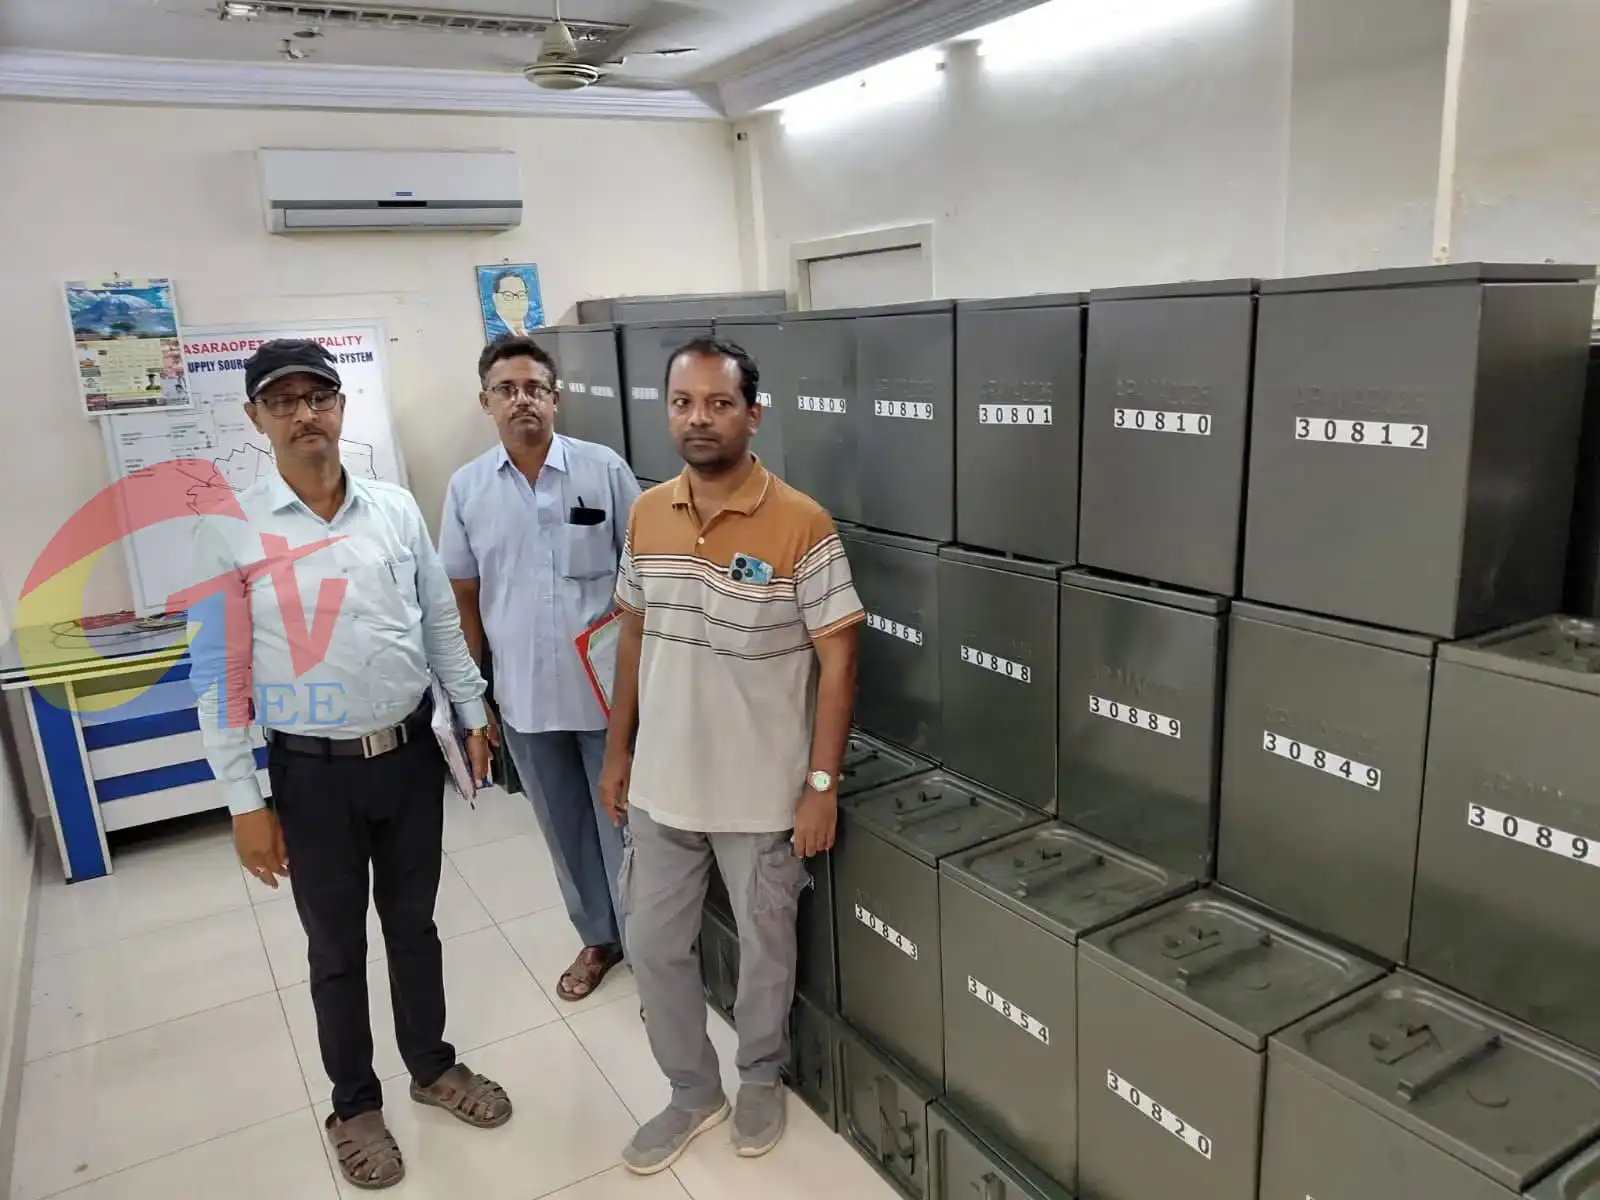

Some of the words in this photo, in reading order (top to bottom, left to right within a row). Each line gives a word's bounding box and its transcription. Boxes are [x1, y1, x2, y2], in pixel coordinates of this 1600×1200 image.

[183, 339, 265, 355] ASARAOPET
[187, 361, 216, 373] UPPLY
[340, 351, 374, 364] SYSTEM
[799, 396, 846, 412] 30809
[876, 401, 933, 418] 30819
[980, 407, 1051, 423] 30801
[1115, 409, 1209, 434] 30810
[1297, 418, 1425, 447] 30812
[867, 613, 922, 644] 30865
[962, 646, 1030, 682] 30808
[1091, 696, 1180, 737] 30889
[1265, 733, 1380, 788] 30849
[856, 905, 918, 958] 30843
[969, 978, 1049, 1042] 30854
[1108, 1072, 1211, 1155] 30820
